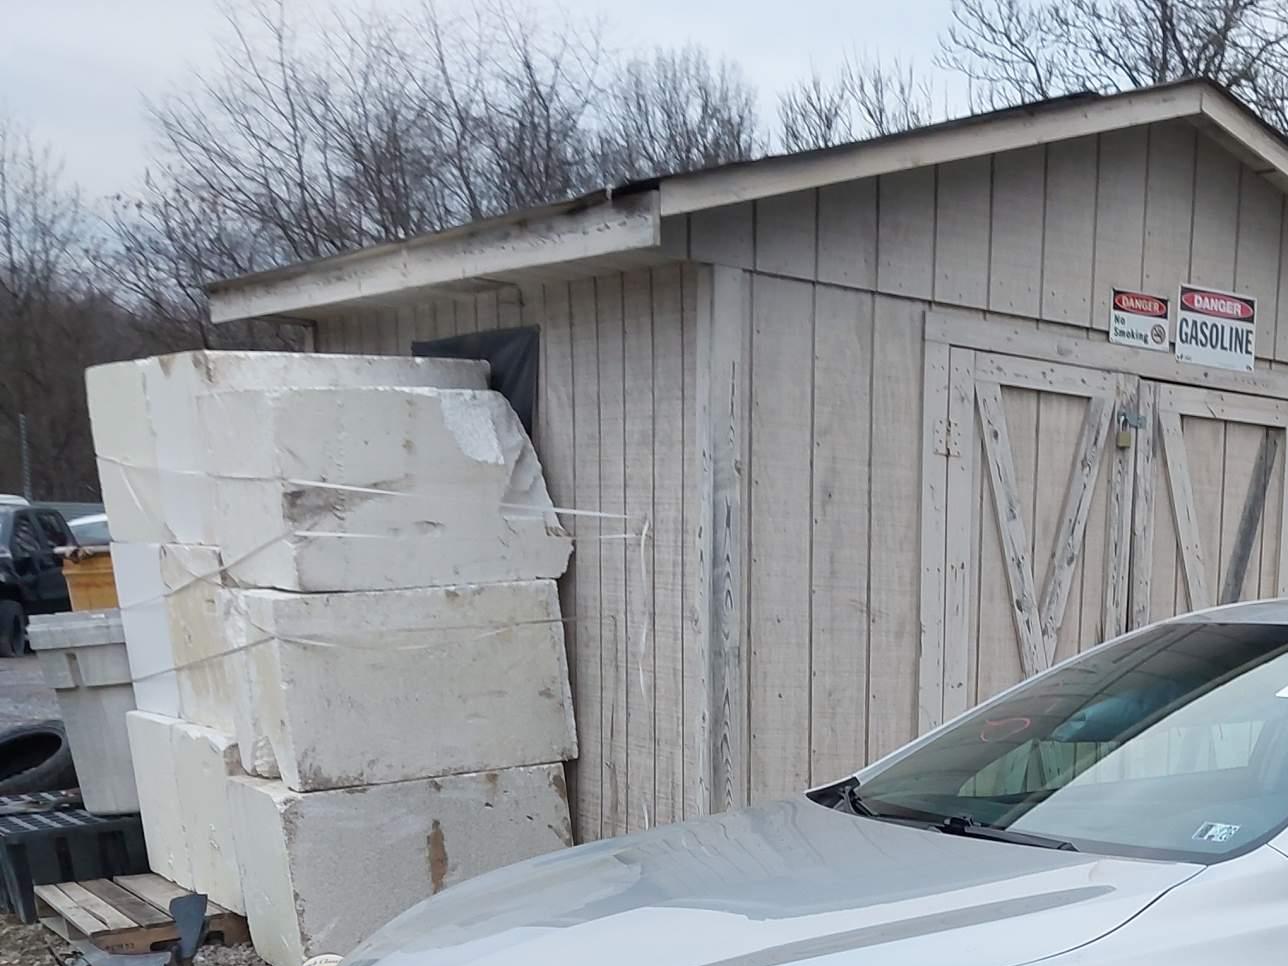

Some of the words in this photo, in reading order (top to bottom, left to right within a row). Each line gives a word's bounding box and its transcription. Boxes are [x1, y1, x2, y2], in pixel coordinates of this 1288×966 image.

[1122, 295, 1160, 313] DANGER
[1194, 294, 1242, 316] DANGER
[1114, 314, 1126, 326] No
[1114, 327, 1149, 345] Smoking
[1179, 317, 1254, 355] GASOLINE
